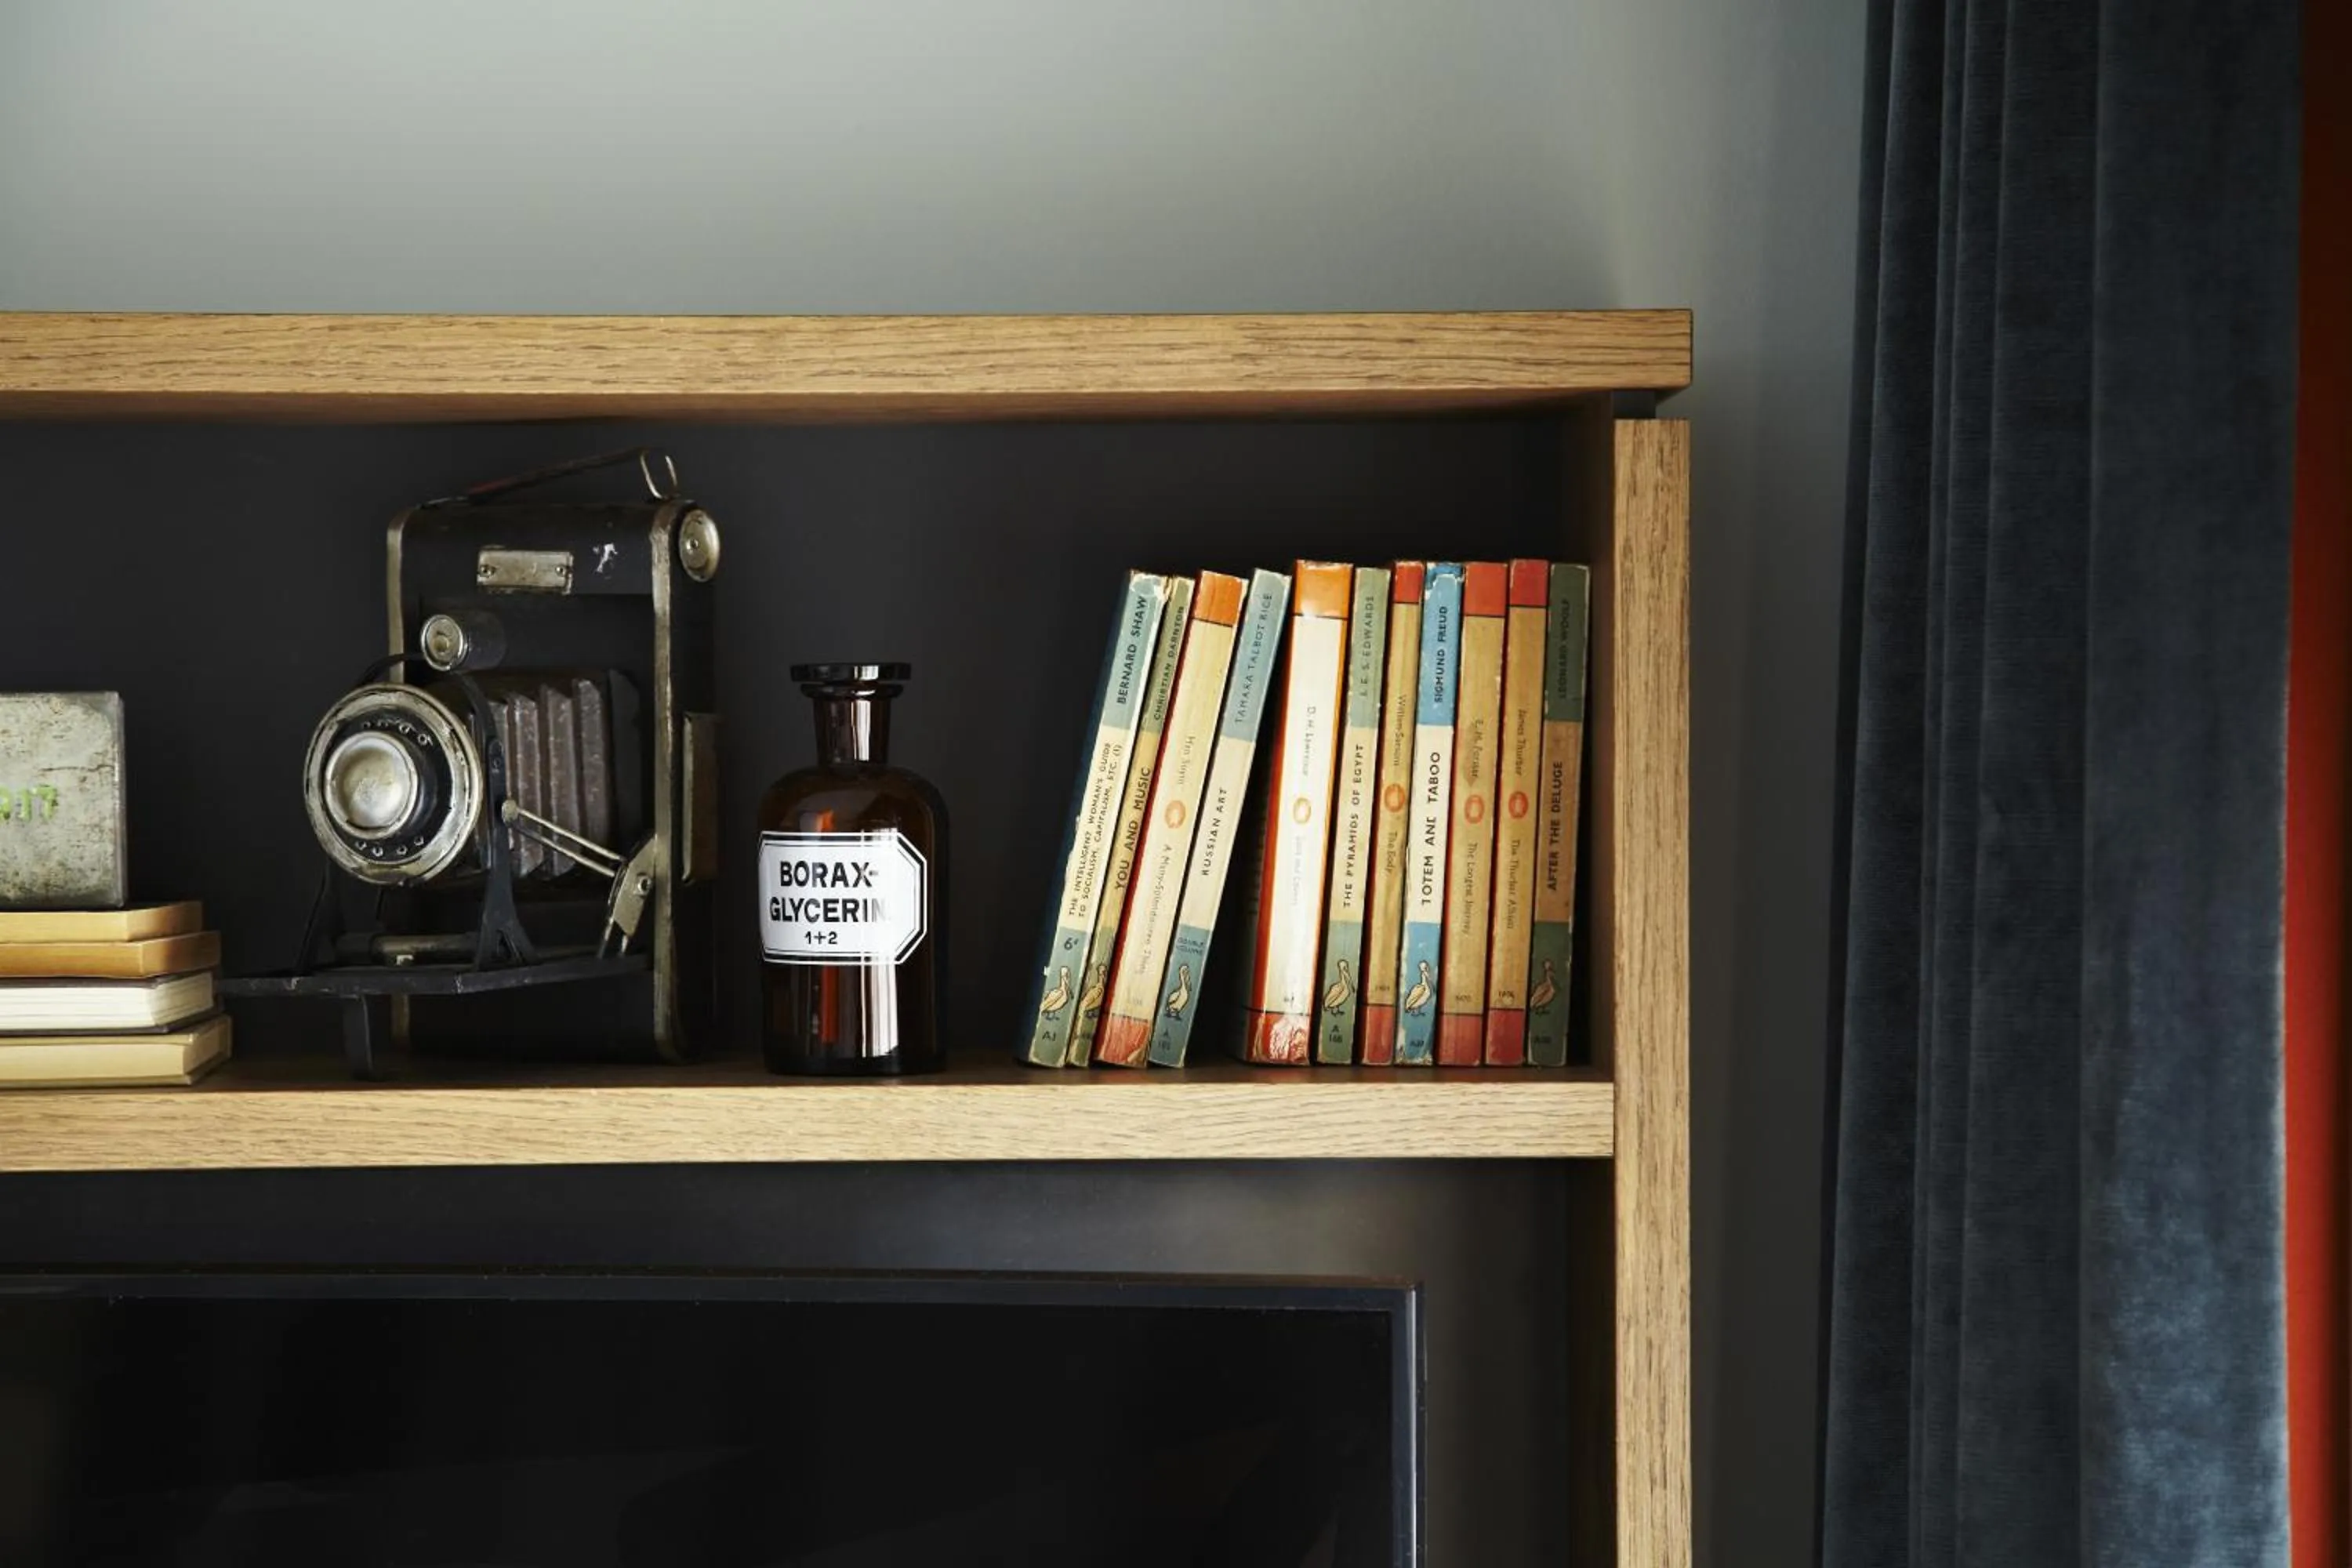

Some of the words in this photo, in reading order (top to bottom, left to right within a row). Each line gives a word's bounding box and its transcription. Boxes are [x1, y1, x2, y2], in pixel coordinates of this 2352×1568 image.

[1363, 595, 1374, 657] EDWARDS
[1437, 605, 1448, 643] FREUD
[1116, 643, 1137, 705] BERNARD
[1131, 595, 1148, 637] SHAW
[1434, 648, 1446, 703] SIGMUND
[1353, 742, 1365, 784] EGYPT
[1427, 751, 1441, 804] TABOO
[1351, 789, 1362, 806] OF
[1551, 760, 1563, 813] DELUGE
[1114, 858, 1130, 891] YOU
[1123, 819, 1139, 852] AND
[1133, 766, 1152, 811] MUSIC
[1200, 817, 1222, 877] RUSSIAN
[1216, 787, 1229, 814] ART
[1345, 813, 1359, 877] PYRAMIDS
[1549, 820, 1561, 846] THE
[779, 860, 879, 888] BORAX-
[1421, 855, 1434, 906] TOTEM
[1547, 851, 1559, 891] AFTER
[1068, 898, 1079, 916] THE
[1078, 905, 1087, 917] TO
[1343, 883, 1353, 909] THE
[804, 931, 838, 945] 1+2
